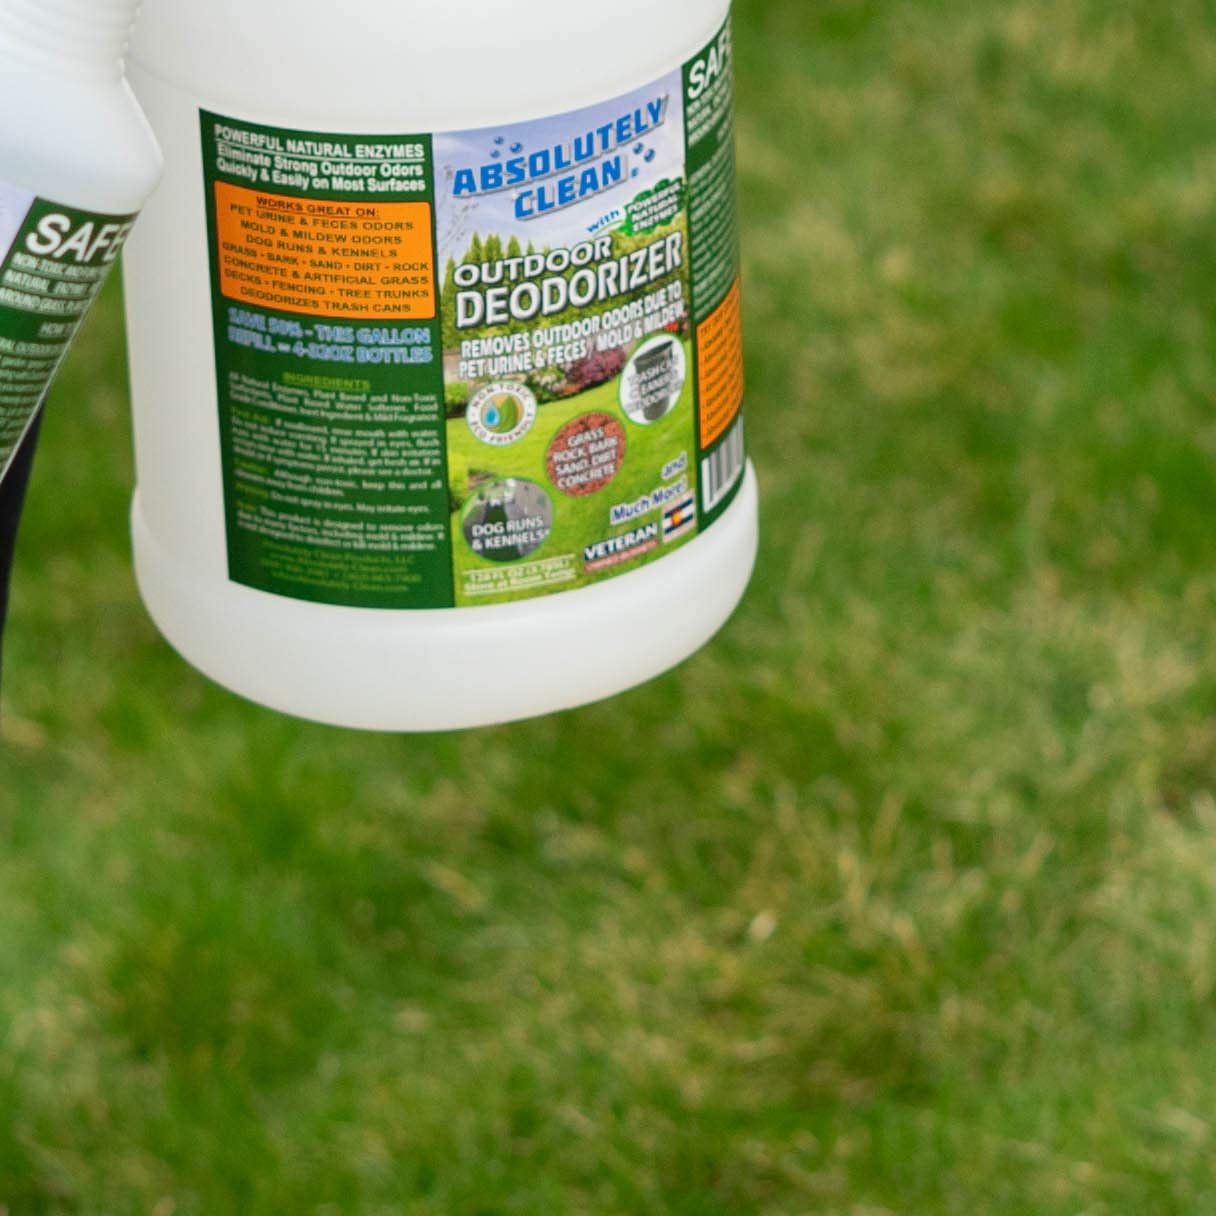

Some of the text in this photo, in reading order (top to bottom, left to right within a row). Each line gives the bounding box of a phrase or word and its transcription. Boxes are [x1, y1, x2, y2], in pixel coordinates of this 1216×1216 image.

[214, 123, 424, 158] POWERFUL NATURAL ENZYMES
[453, 96, 665, 196] ABSOLUTELY
[217, 141, 424, 177] Eliminate Strong Outdoor Odors
[217, 157, 426, 192] Quickly & Easily on Most Surfaces
[515, 155, 622, 220] CLEAN
[230, 203, 253, 216] PET
[256, 209, 297, 226] URINE
[312, 218, 358, 230] FECES
[362, 220, 414, 231] ODORS
[257, 196, 303, 211] WORKS
[306, 203, 351, 216] GREAT
[240, 219, 276, 235] MOLD
[292, 230, 348, 244] MILDEW
[587, 209, 620, 233] with
[26, 213, 131, 262] SAFE
[246, 234, 273, 248] DOG
[276, 240, 313, 254] RUNS
[331, 246, 398, 257] KENNELS
[224, 255, 287, 277] CONCRETE
[304, 272, 376, 285] ARTIFICIAL
[380, 276, 429, 285] GRASS
[310, 256, 343, 270] SAND
[354, 261, 382, 271] DIRT
[393, 261, 429, 271] ROCK
[454, 235, 613, 287] OUTDOOR
[456, 231, 683, 328] DEODORIZER
[240, 285, 411, 313] DEODORIZES TRASH CANS
[338, 288, 371, 298] TREE
[376, 289, 429, 299] TRUNKS
[461, 280, 683, 359] REMOVES OUTDOOR ODORS DUE TO
[313, 323, 355, 344] THIS
[356, 327, 432, 345] GALLON
[459, 358, 485, 379] PET
[487, 350, 533, 376] URINE
[534, 349, 546, 368] &
[548, 341, 588, 365] FECES
[596, 327, 632, 351] MOLD
[633, 322, 643, 339] &
[644, 301, 685, 333] MILDEW
[356, 346, 433, 364] BOTTLES
[568, 427, 605, 448] GRASS
[588, 436, 619, 454] BARK
[557, 465, 616, 489] CONCRETE
[612, 497, 650, 520] Much
[472, 516, 543, 536] DOG RUNS
[472, 539, 482, 551] &
[585, 523, 658, 560] VETERAN
